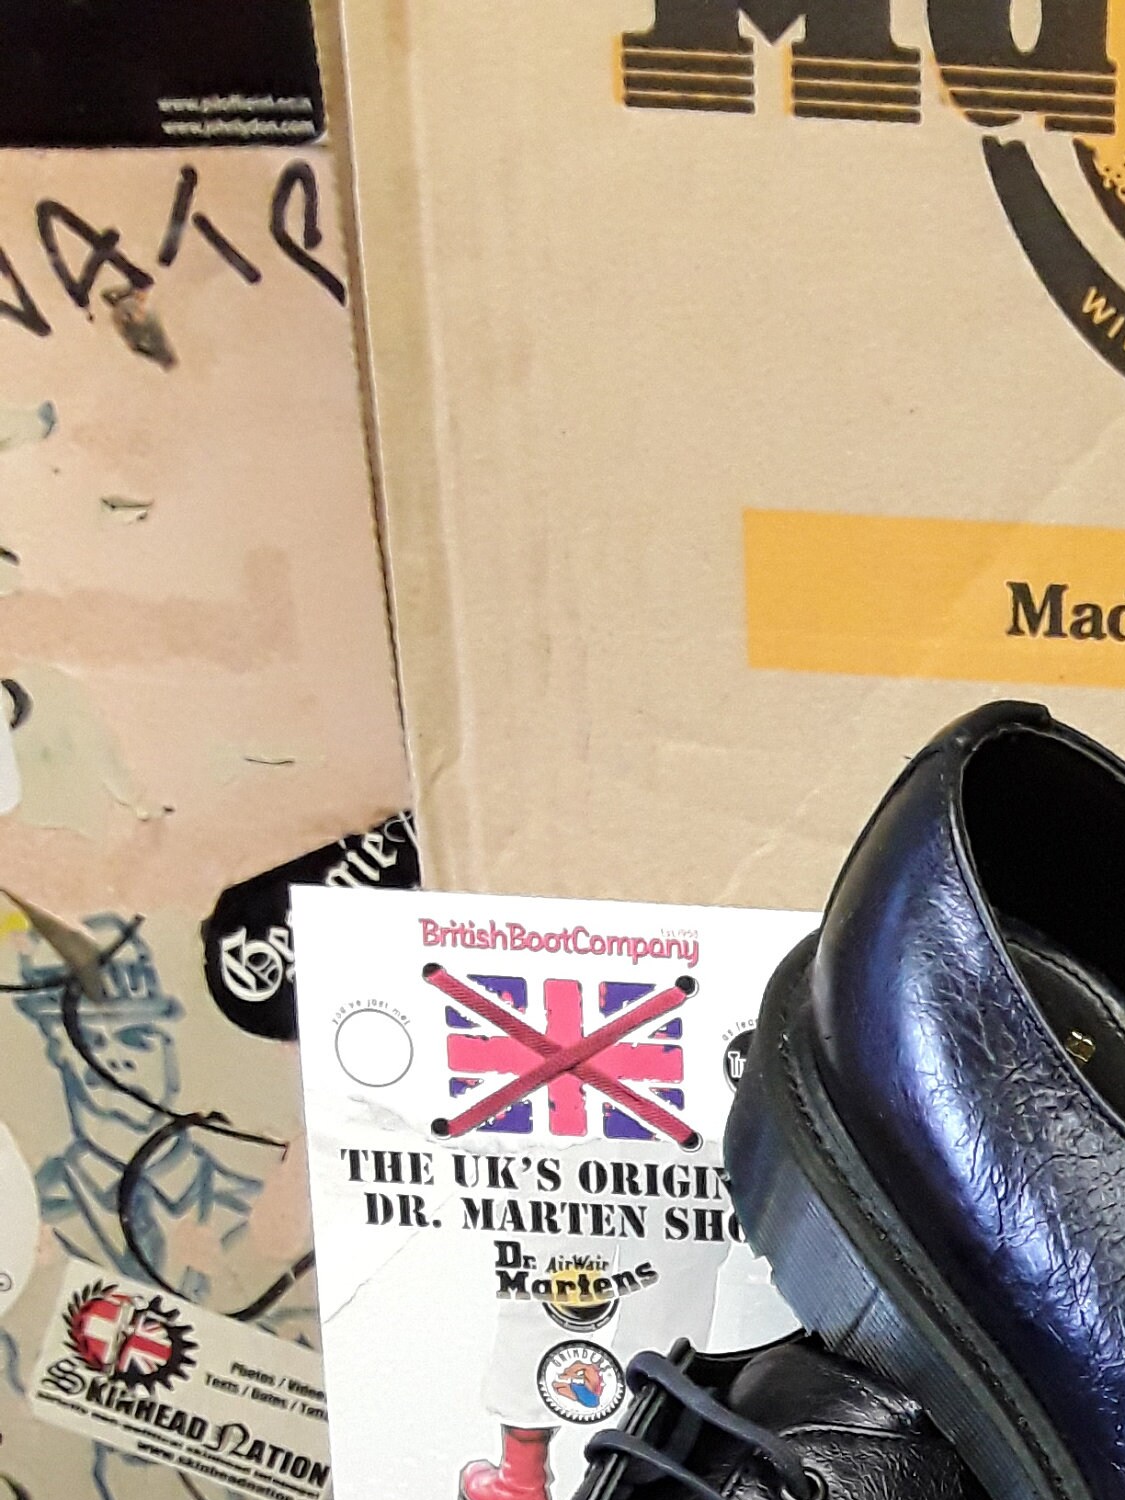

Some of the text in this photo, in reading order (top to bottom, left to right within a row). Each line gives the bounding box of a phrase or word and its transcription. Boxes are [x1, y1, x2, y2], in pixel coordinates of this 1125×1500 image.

[340, 1147, 733, 1200] THE UK'S ORIGI
[364, 1191, 443, 1229] DR.
[460, 1196, 648, 1239] MARTEN
[493, 1239, 538, 1270] Dr.
[545, 1253, 610, 1274] AirWair
[494, 1261, 660, 1302] Martens
[203, 1422, 331, 1489] NATION
